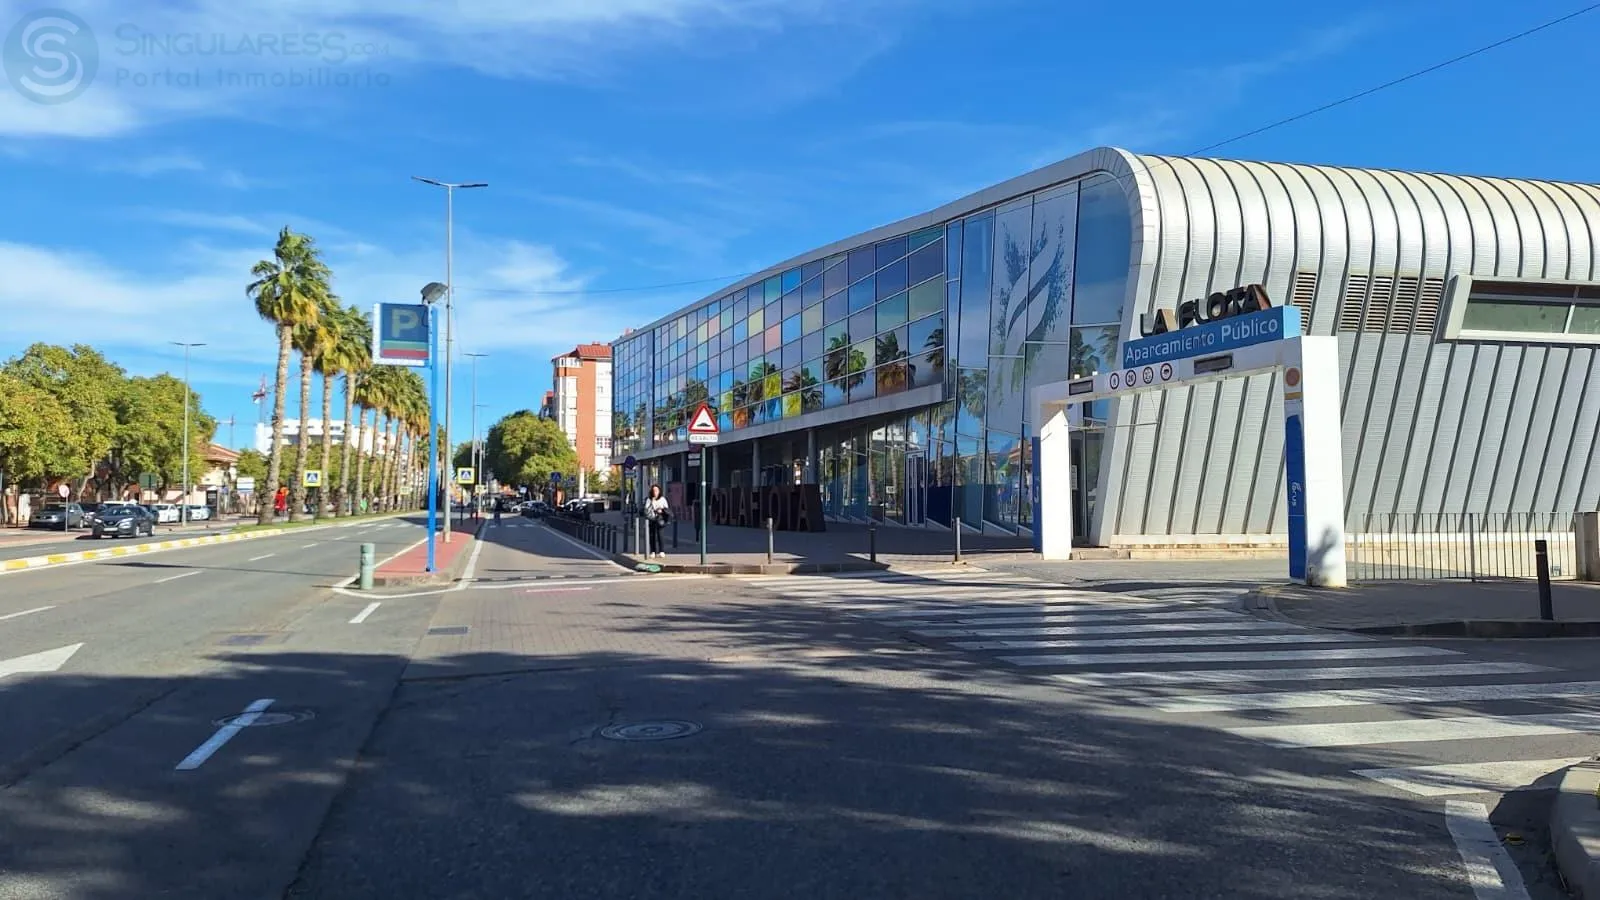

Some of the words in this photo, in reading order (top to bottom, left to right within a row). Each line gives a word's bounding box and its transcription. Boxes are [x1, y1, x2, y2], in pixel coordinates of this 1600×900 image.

[392, 308, 419, 338] P
[1140, 308, 1173, 338] LA
[1179, 285, 1271, 329] FLOTA
[1125, 332, 1215, 363] Aparcamiento
[1221, 317, 1279, 344] Público
